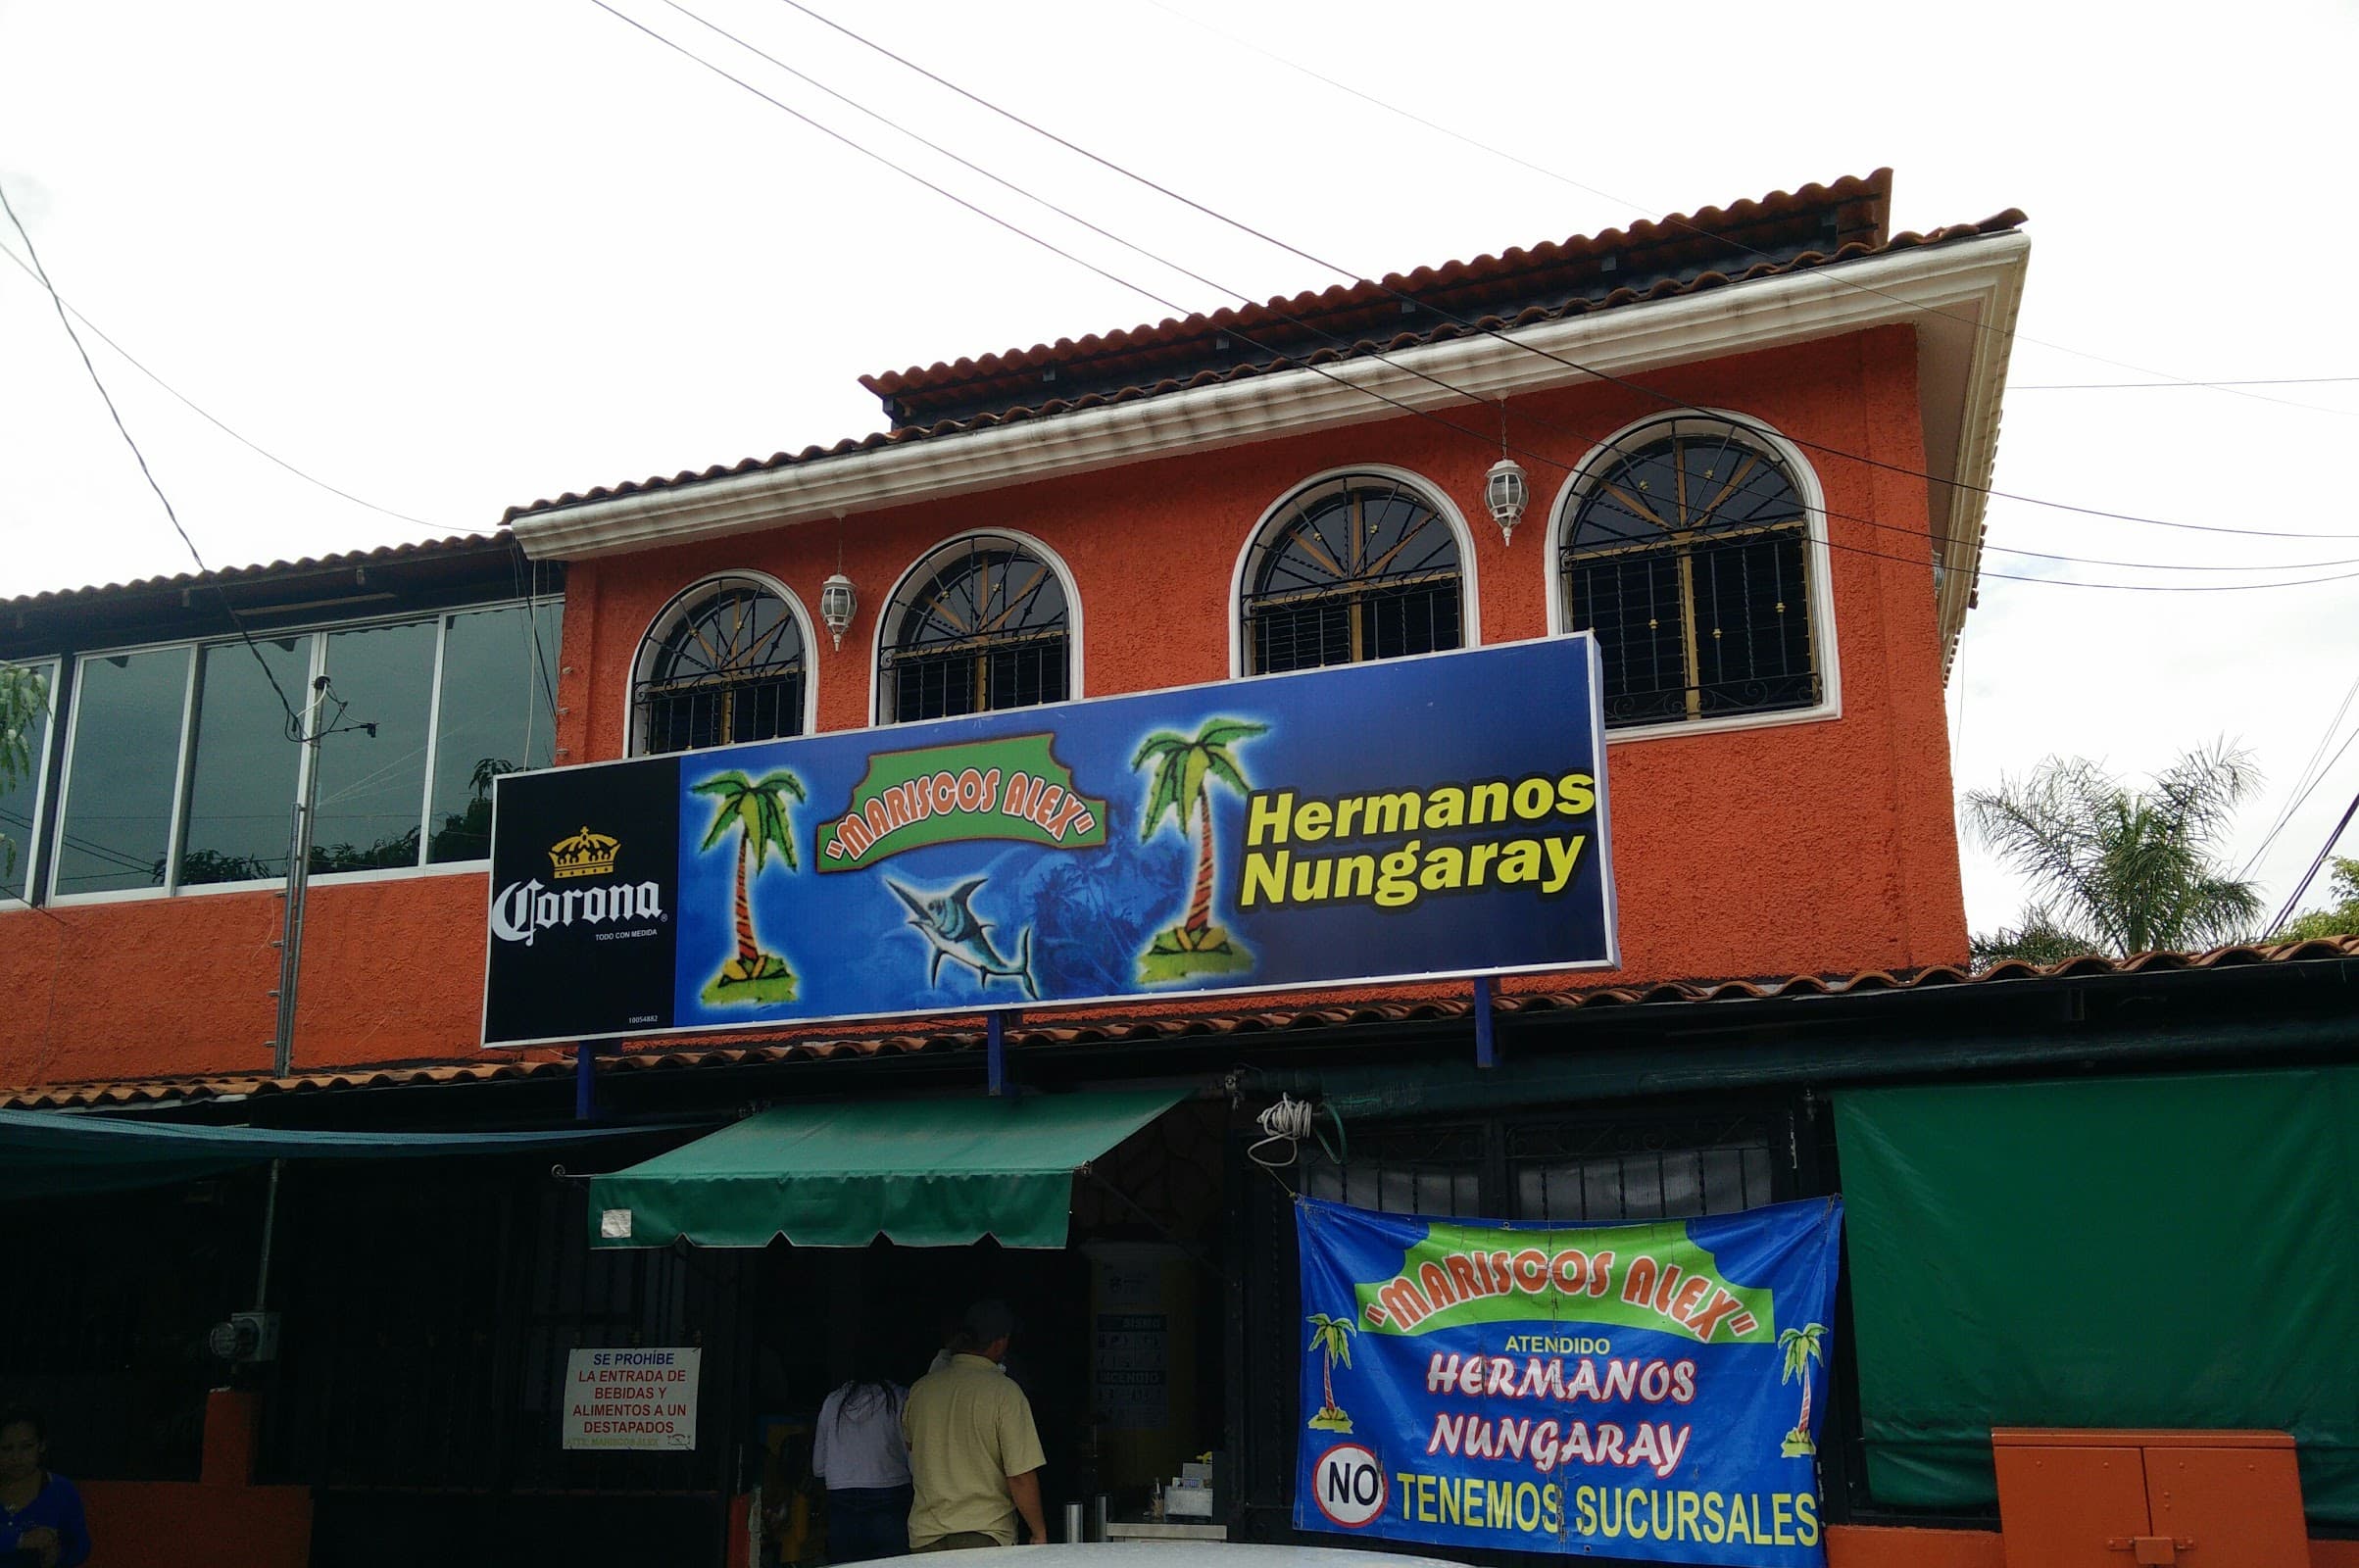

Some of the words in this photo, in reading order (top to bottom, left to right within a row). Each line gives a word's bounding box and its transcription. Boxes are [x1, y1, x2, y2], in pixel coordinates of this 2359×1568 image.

[1247, 773, 1596, 847] Hermanos
[1241, 835, 1586, 907] Nungaray
[491, 878, 663, 947] Corona
[595, 932, 614, 941] TODO
[615, 930, 630, 940] CON
[631, 928, 658, 938] MEDIDA
[1504, 1335, 1611, 1355] ATENDIDO
[593, 1353, 611, 1366] SE
[578, 1370, 596, 1383] LA
[599, 1370, 663, 1383] ENTRADA
[667, 1369, 686, 1382] DE
[1425, 1351, 1698, 1404] HERMANOS
[594, 1387, 655, 1399] BEBIDAS
[658, 1387, 667, 1399] Y
[572, 1403, 651, 1416] ALIMENTOS
[583, 1421, 674, 1434] DESTAPADOS
[1426, 1413, 1692, 1479] NUNGARAY
[1328, 1461, 1380, 1506] NO
[1397, 1472, 1562, 1534] TENEMOS
[1576, 1484, 1819, 1546] SUCURSALES
